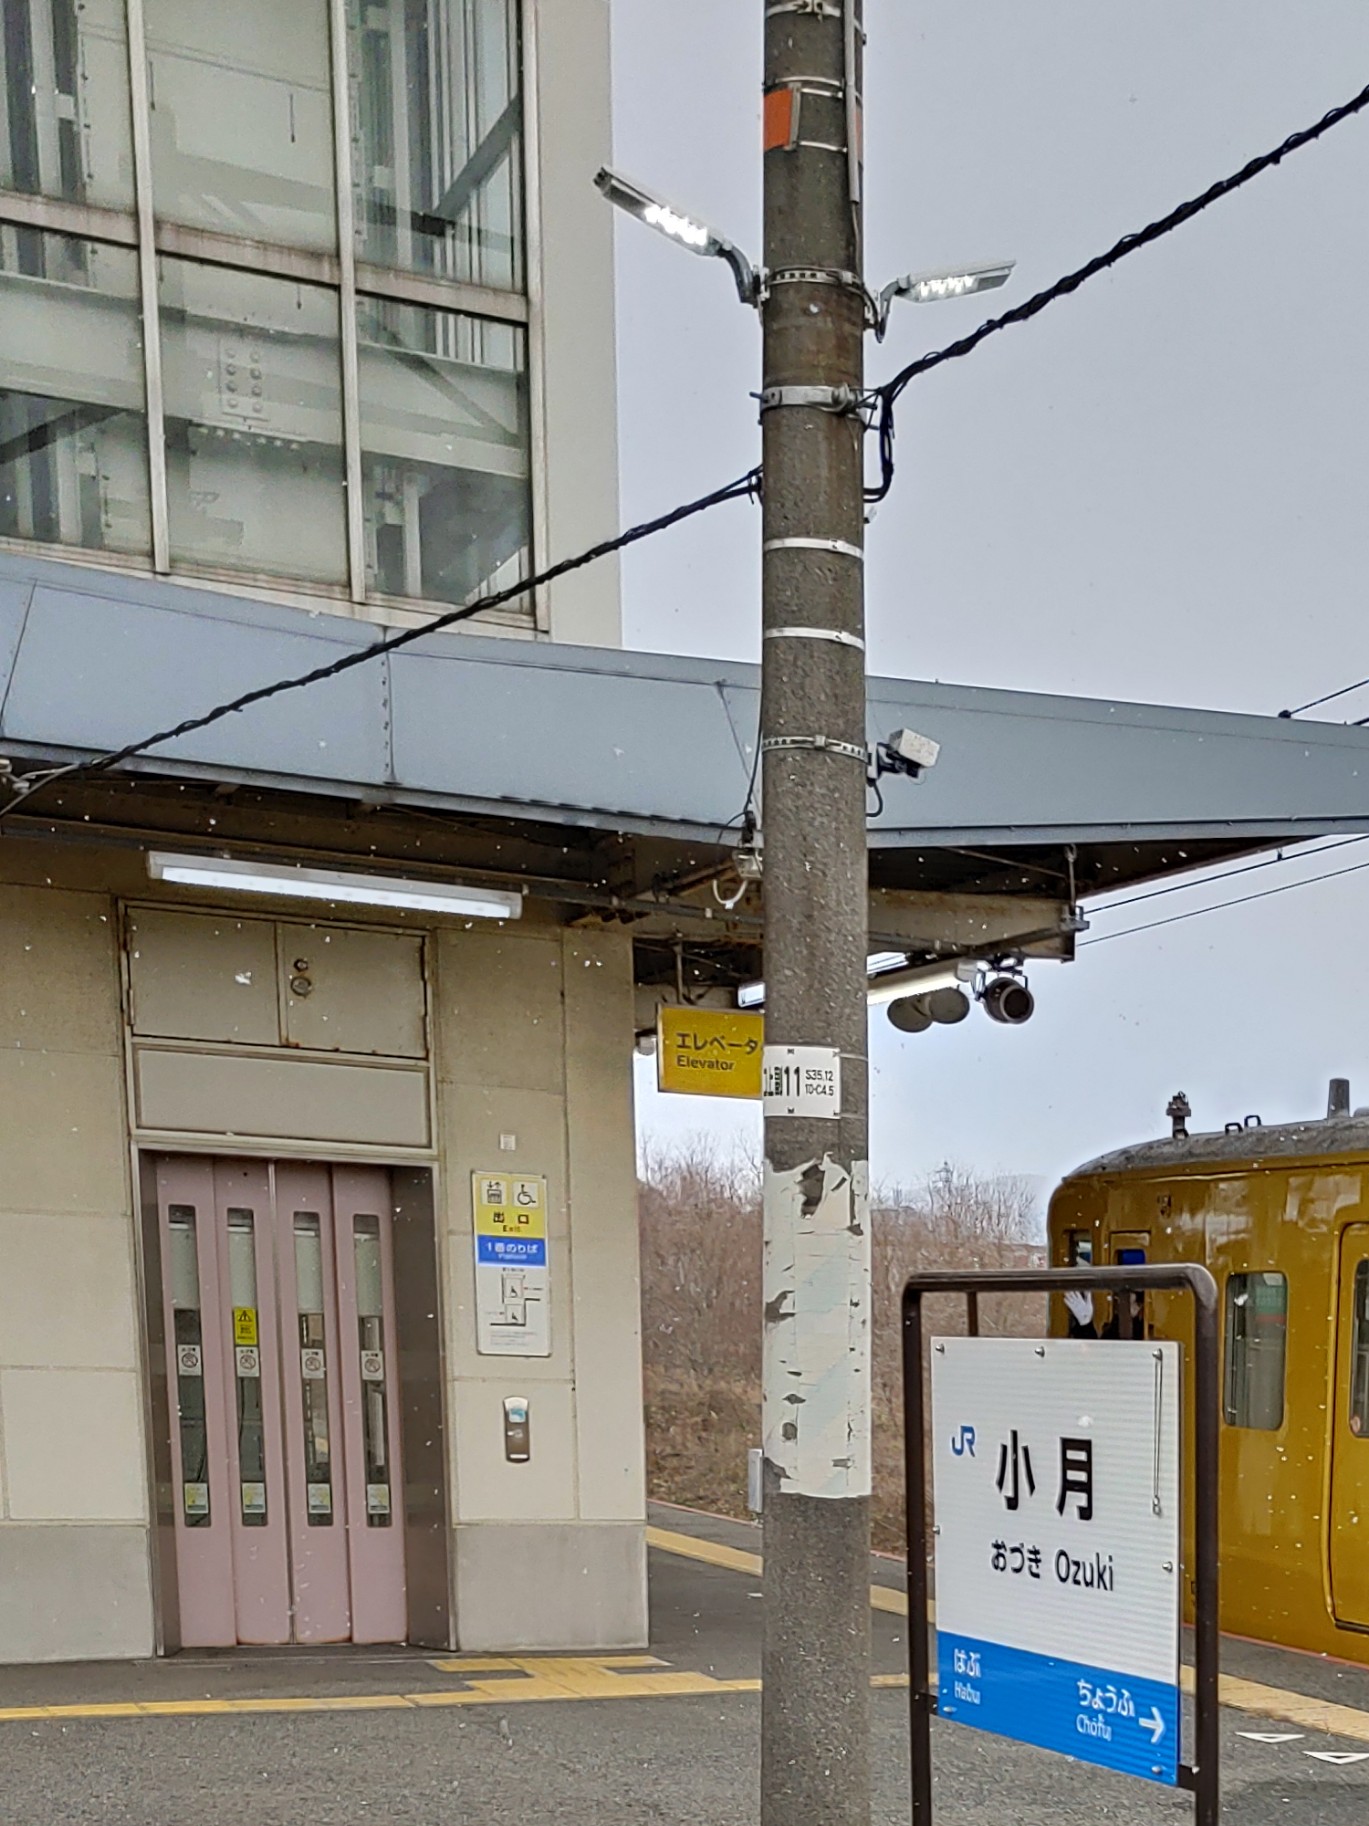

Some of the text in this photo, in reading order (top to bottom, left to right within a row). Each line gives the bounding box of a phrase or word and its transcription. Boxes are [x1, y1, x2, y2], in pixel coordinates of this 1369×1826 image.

[677, 1055, 735, 1071] Elevator
[951, 1425, 976, 1457] JR
[995, 1429, 1094, 1521] 小月
[991, 1540, 1114, 1591] おづき Ozuki
[953, 1648, 981, 1679] はぶ
[954, 1681, 981, 1705] Habu
[1076, 1678, 1135, 1717] ちょうふ
